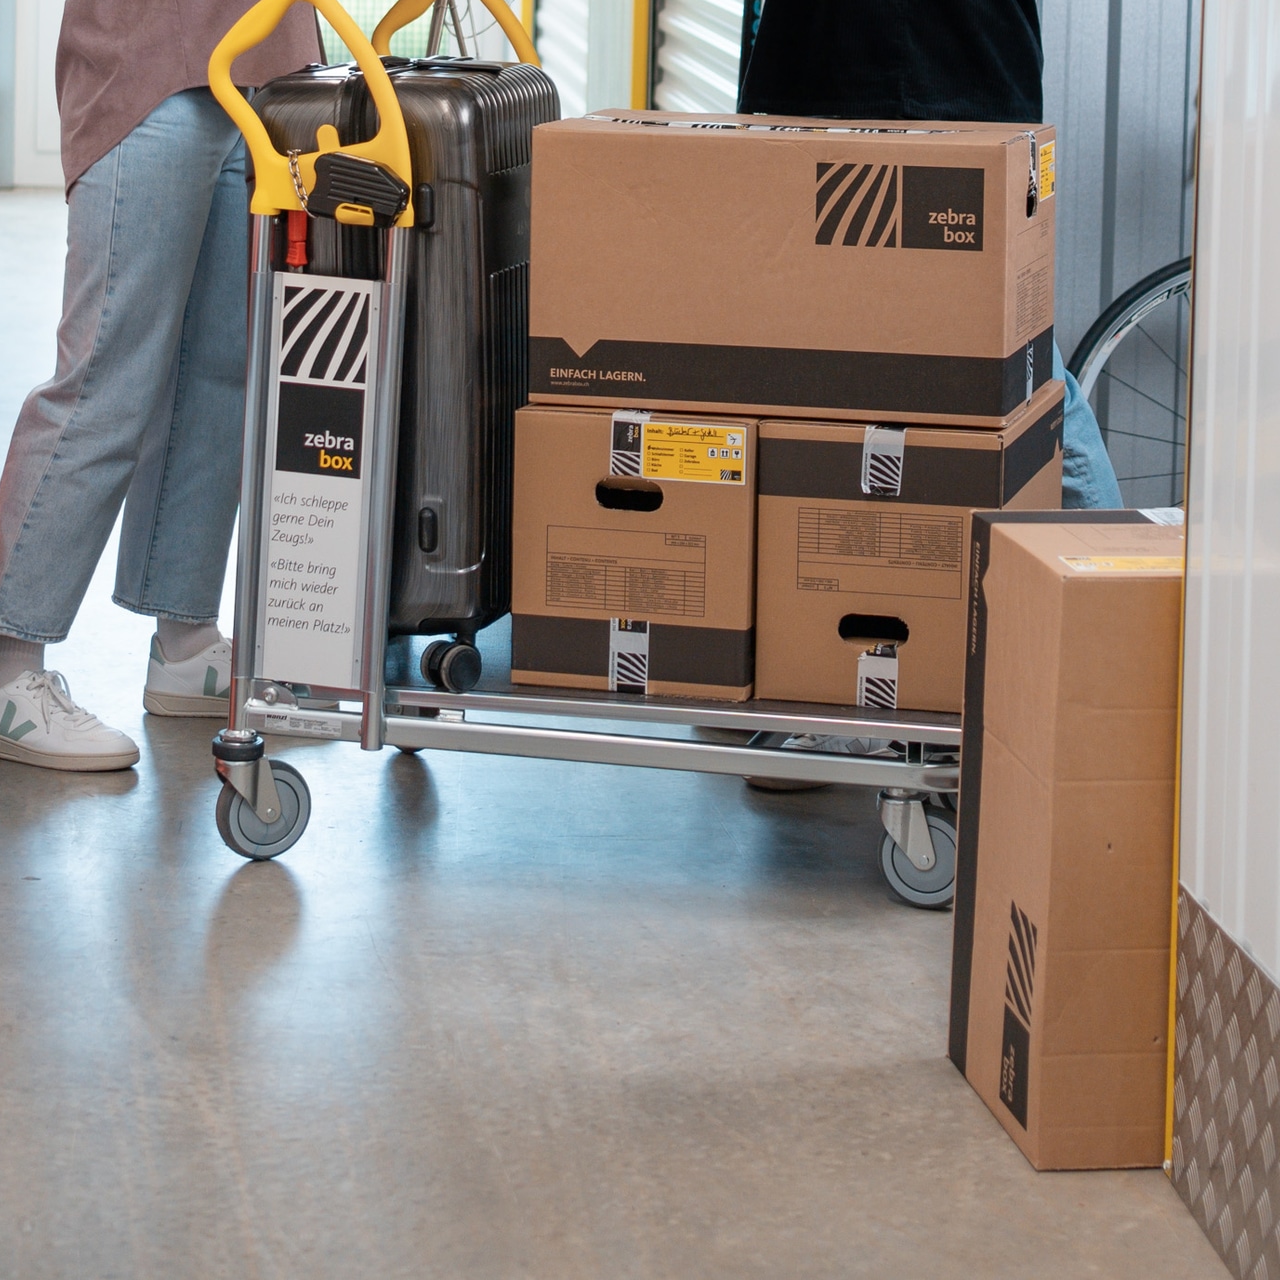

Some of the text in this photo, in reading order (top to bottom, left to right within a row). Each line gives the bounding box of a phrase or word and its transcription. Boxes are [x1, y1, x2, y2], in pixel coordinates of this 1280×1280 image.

[928, 208, 976, 226] zebra
[943, 226, 976, 244] box
[550, 367, 647, 382] EINFACH LAGERN.
[304, 430, 354, 451] zebra
[319, 449, 353, 471] box
[274, 492, 349, 513] «Ich schleppe
[272, 513, 335, 528] gerne Dein
[271, 529, 314, 547] Zeugs!»
[270, 558, 337, 580] «Bitte bring
[269, 578, 339, 595] mich wieder
[267, 597, 324, 613] zurück an
[267, 616, 351, 634] meinen Platz!»
[266, 713, 288, 721] wanzl
